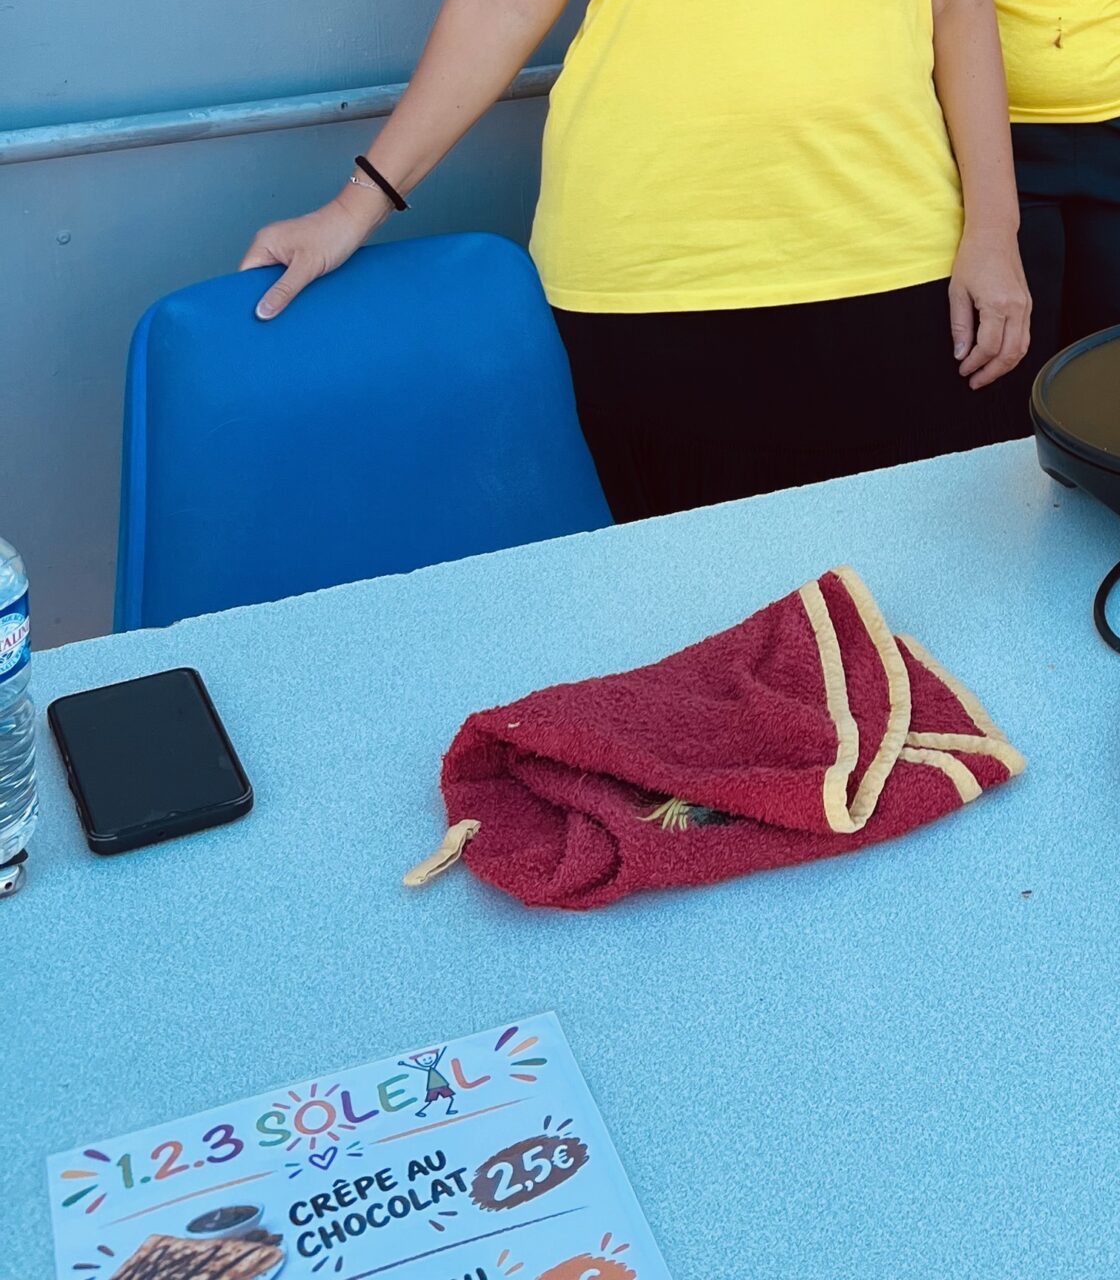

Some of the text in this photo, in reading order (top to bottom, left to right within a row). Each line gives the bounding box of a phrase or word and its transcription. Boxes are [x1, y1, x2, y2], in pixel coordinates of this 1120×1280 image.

[115, 1123, 245, 1190] 1.2.3
[288, 1149, 447, 1227] CRÊPE AU
[296, 1144, 575, 1258] CHOCOLAT 2,5€
